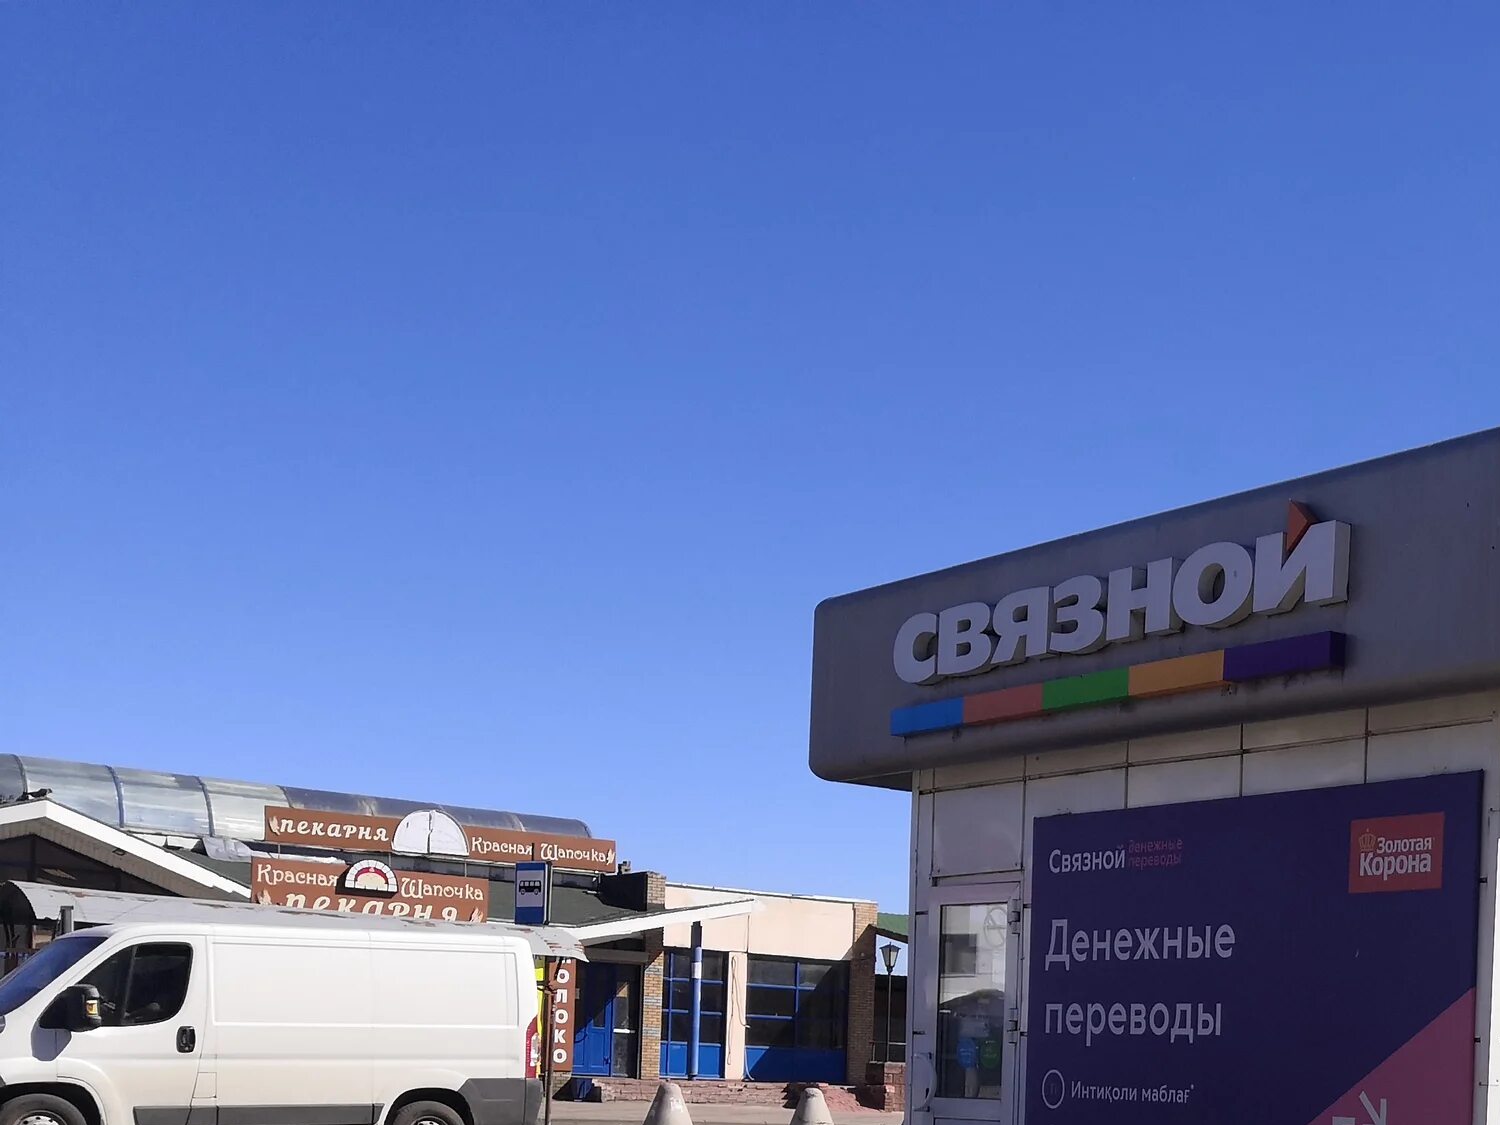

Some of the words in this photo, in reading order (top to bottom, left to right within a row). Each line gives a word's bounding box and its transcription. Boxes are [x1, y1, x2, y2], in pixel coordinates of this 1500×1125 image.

[893, 500, 1351, 686] СВЯЗНОЙ
[471, 836, 533, 856] Красная
[540, 843, 606, 863] Шапочка
[1049, 844, 1125, 873] Связной
[1377, 837, 1432, 853] Золотая
[256, 864, 339, 888] Красная
[401, 878, 484, 901] Шапочка
[1360, 852, 1431, 880] Корона
[1044, 918, 1236, 971] Денежные
[552, 959, 572, 1064] ОЛОКО
[1044, 1002, 1222, 1047] переводы
